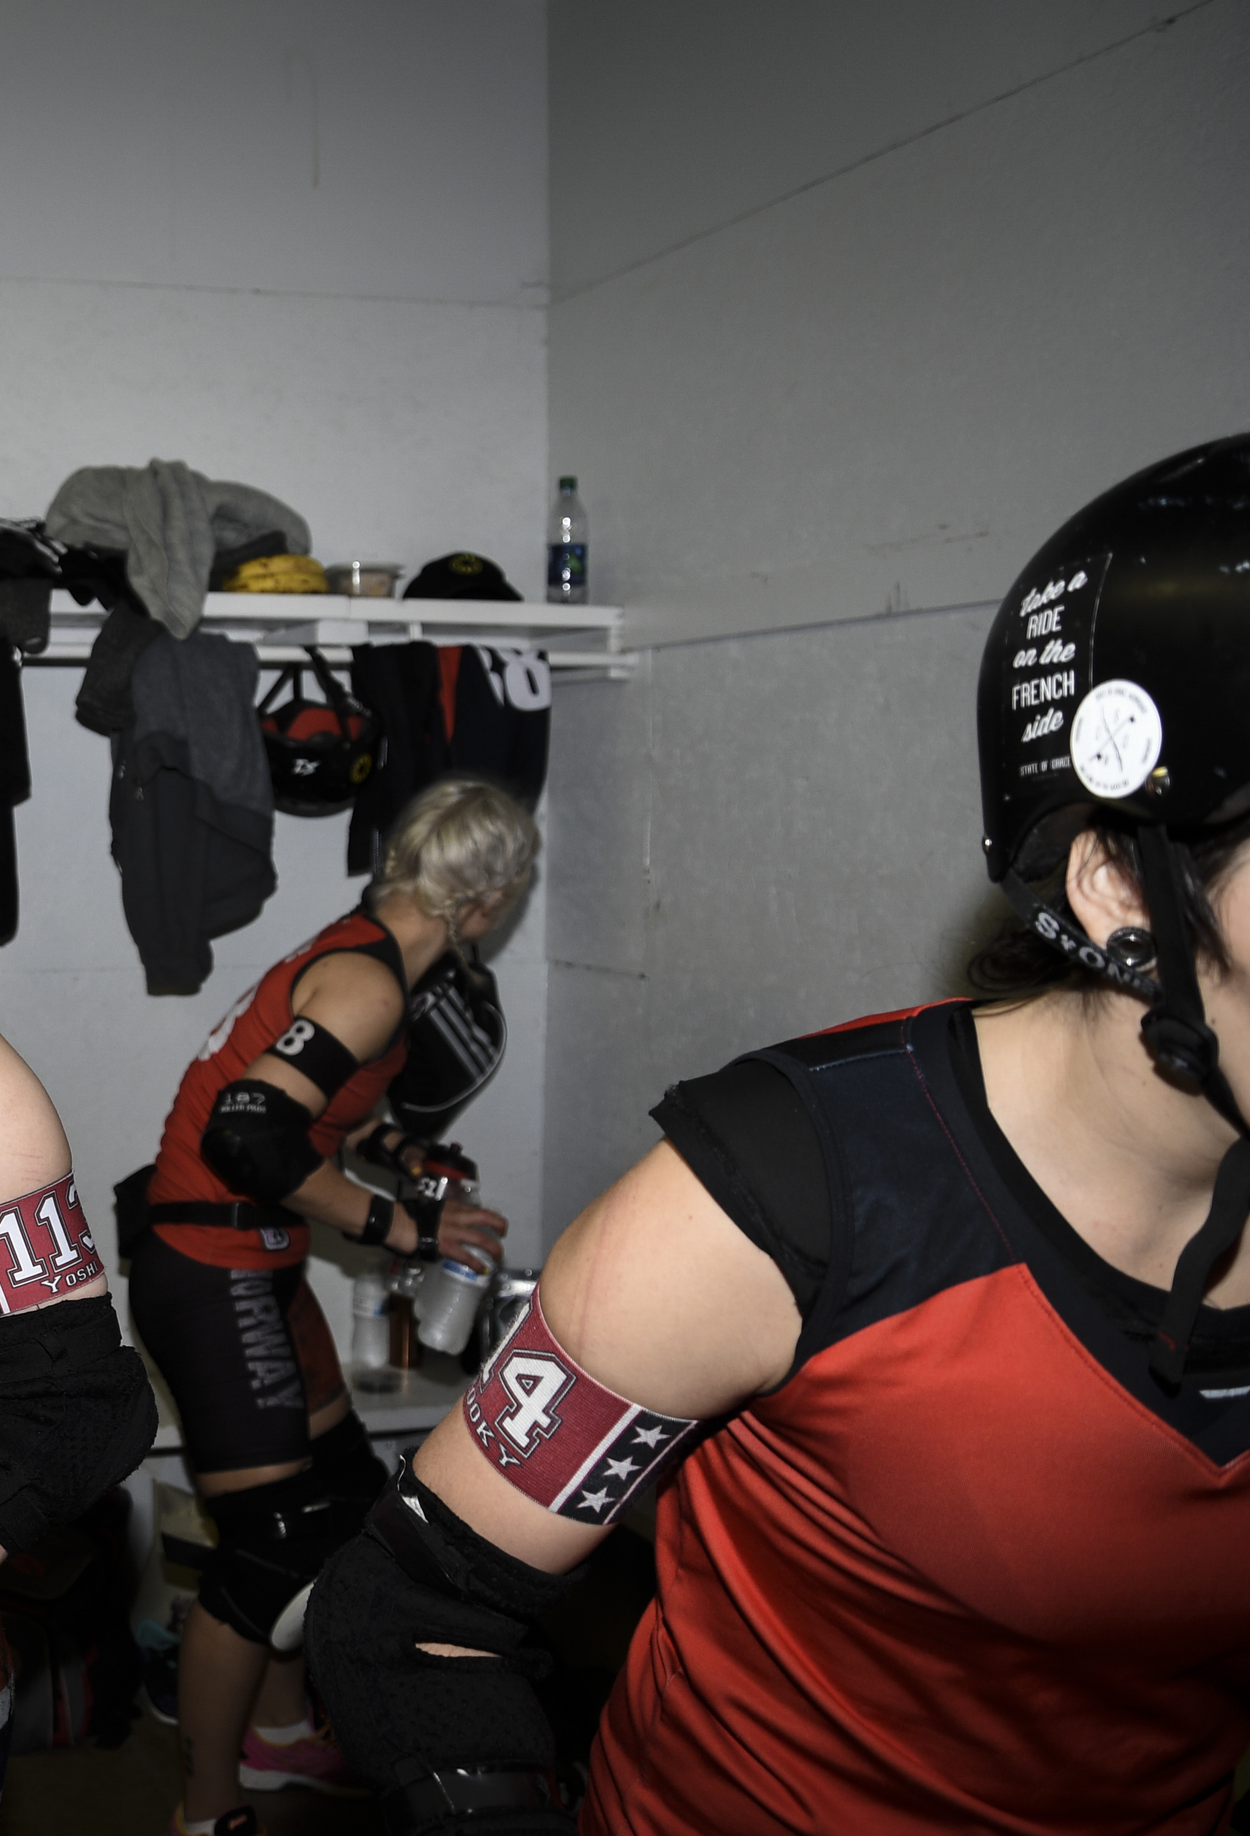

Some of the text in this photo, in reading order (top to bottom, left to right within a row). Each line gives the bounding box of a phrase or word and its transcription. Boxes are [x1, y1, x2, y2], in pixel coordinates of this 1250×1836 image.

[1019, 570, 1088, 617] take a
[1026, 604, 1065, 640] RIDE
[1012, 637, 1076, 669] on the
[1011, 668, 1075, 711] FRENCH
[1020, 706, 1065, 743] side
[1020, 764, 1039, 778] STATE
[40, 1260, 100, 1295] YOSHI
[465, 1386, 524, 1469] OOKY
